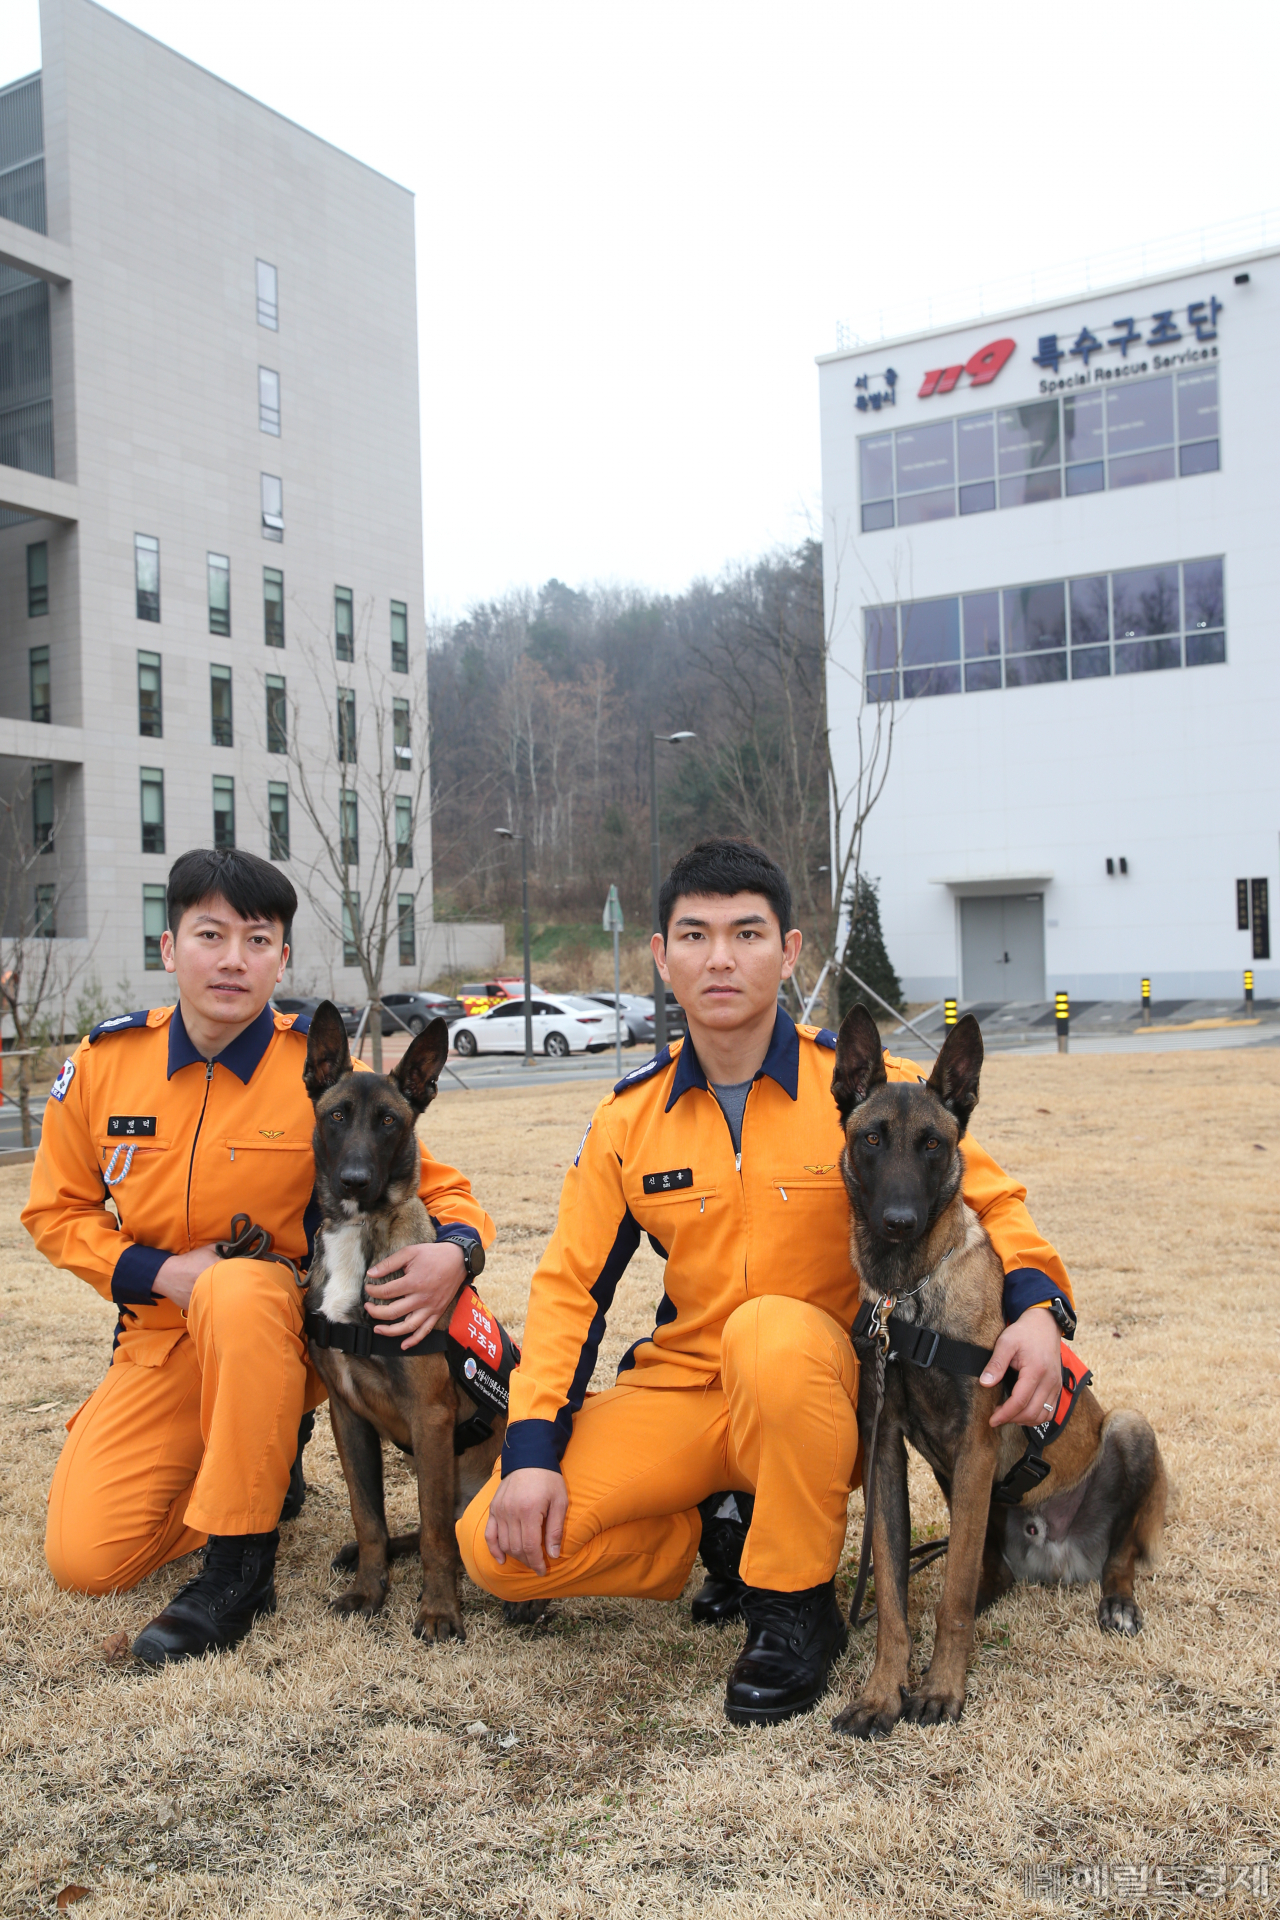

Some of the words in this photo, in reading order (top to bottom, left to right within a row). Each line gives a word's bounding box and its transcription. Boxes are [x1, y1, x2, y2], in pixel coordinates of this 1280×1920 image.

[917, 338, 1017, 398] 119
[1032, 296, 1222, 374] 특수구조단
[1039, 371, 1091, 394] Special
[1095, 361, 1148, 382] Rescue
[1153, 346, 1218, 370] Services
[471, 1295, 493, 1320] 119
[471, 1308, 492, 1334] 인명
[467, 1322, 497, 1359] 구조견
